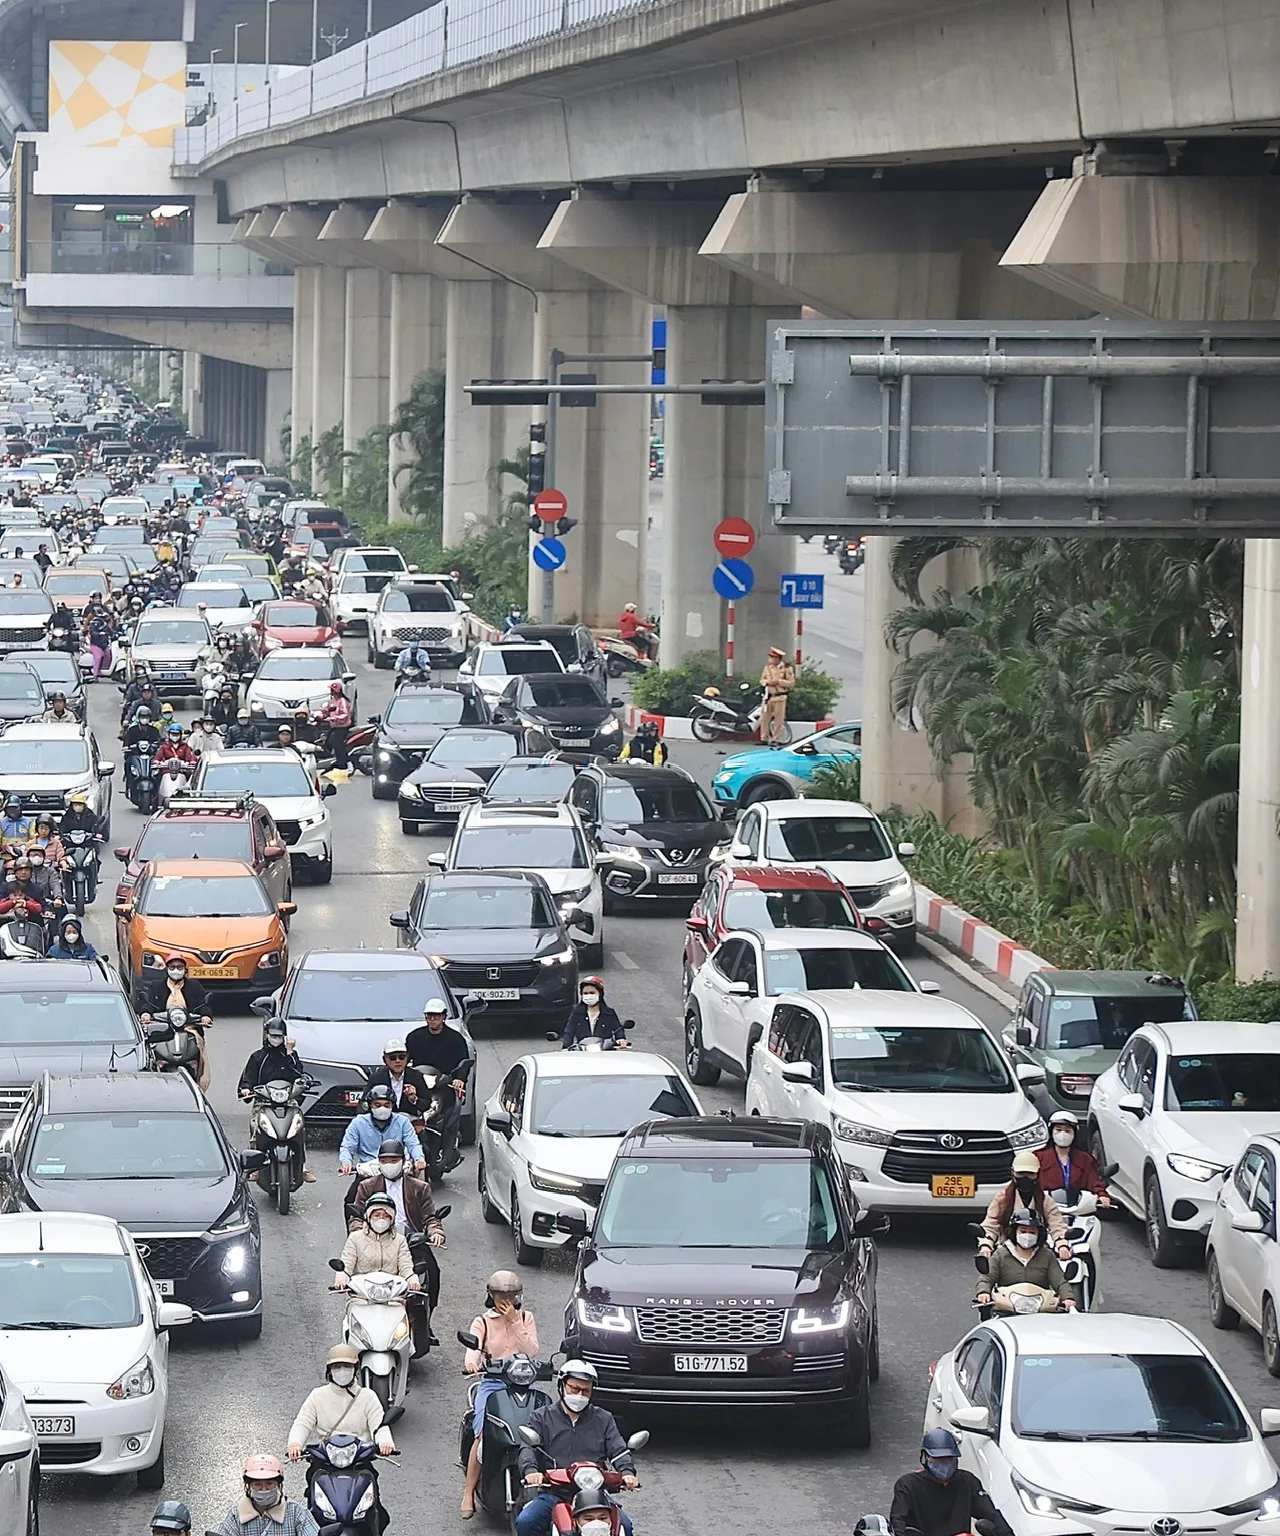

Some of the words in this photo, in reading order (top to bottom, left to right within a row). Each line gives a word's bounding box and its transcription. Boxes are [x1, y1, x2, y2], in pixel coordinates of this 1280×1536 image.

[944, 1176, 963, 1186] 29E
[936, 1186, 970, 1196] 056.37
[645, 1297, 704, 1306] RANGE
[715, 1298, 775, 1306] ROVER
[676, 1356, 746, 1371] 51G-771.52
